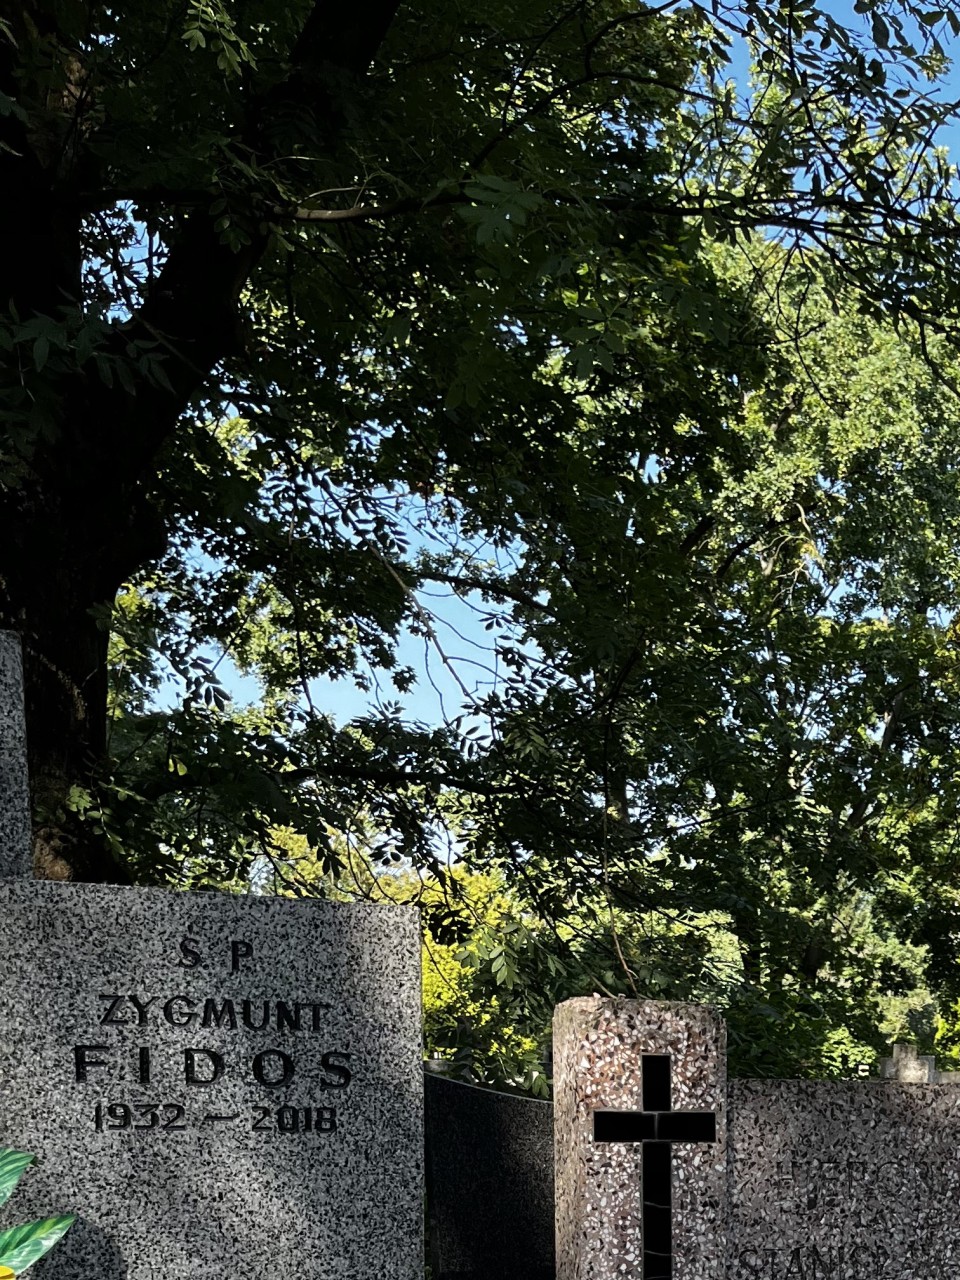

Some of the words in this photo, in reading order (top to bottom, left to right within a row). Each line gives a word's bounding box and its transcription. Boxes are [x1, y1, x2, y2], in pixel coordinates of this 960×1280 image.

[230, 940, 254, 972] P
[99, 994, 331, 1032] ZYGMUNT
[73, 1044, 353, 1090] FIDOS
[95, 1102, 186, 1131] 1932
[251, 1105, 337, 1133] 2018
